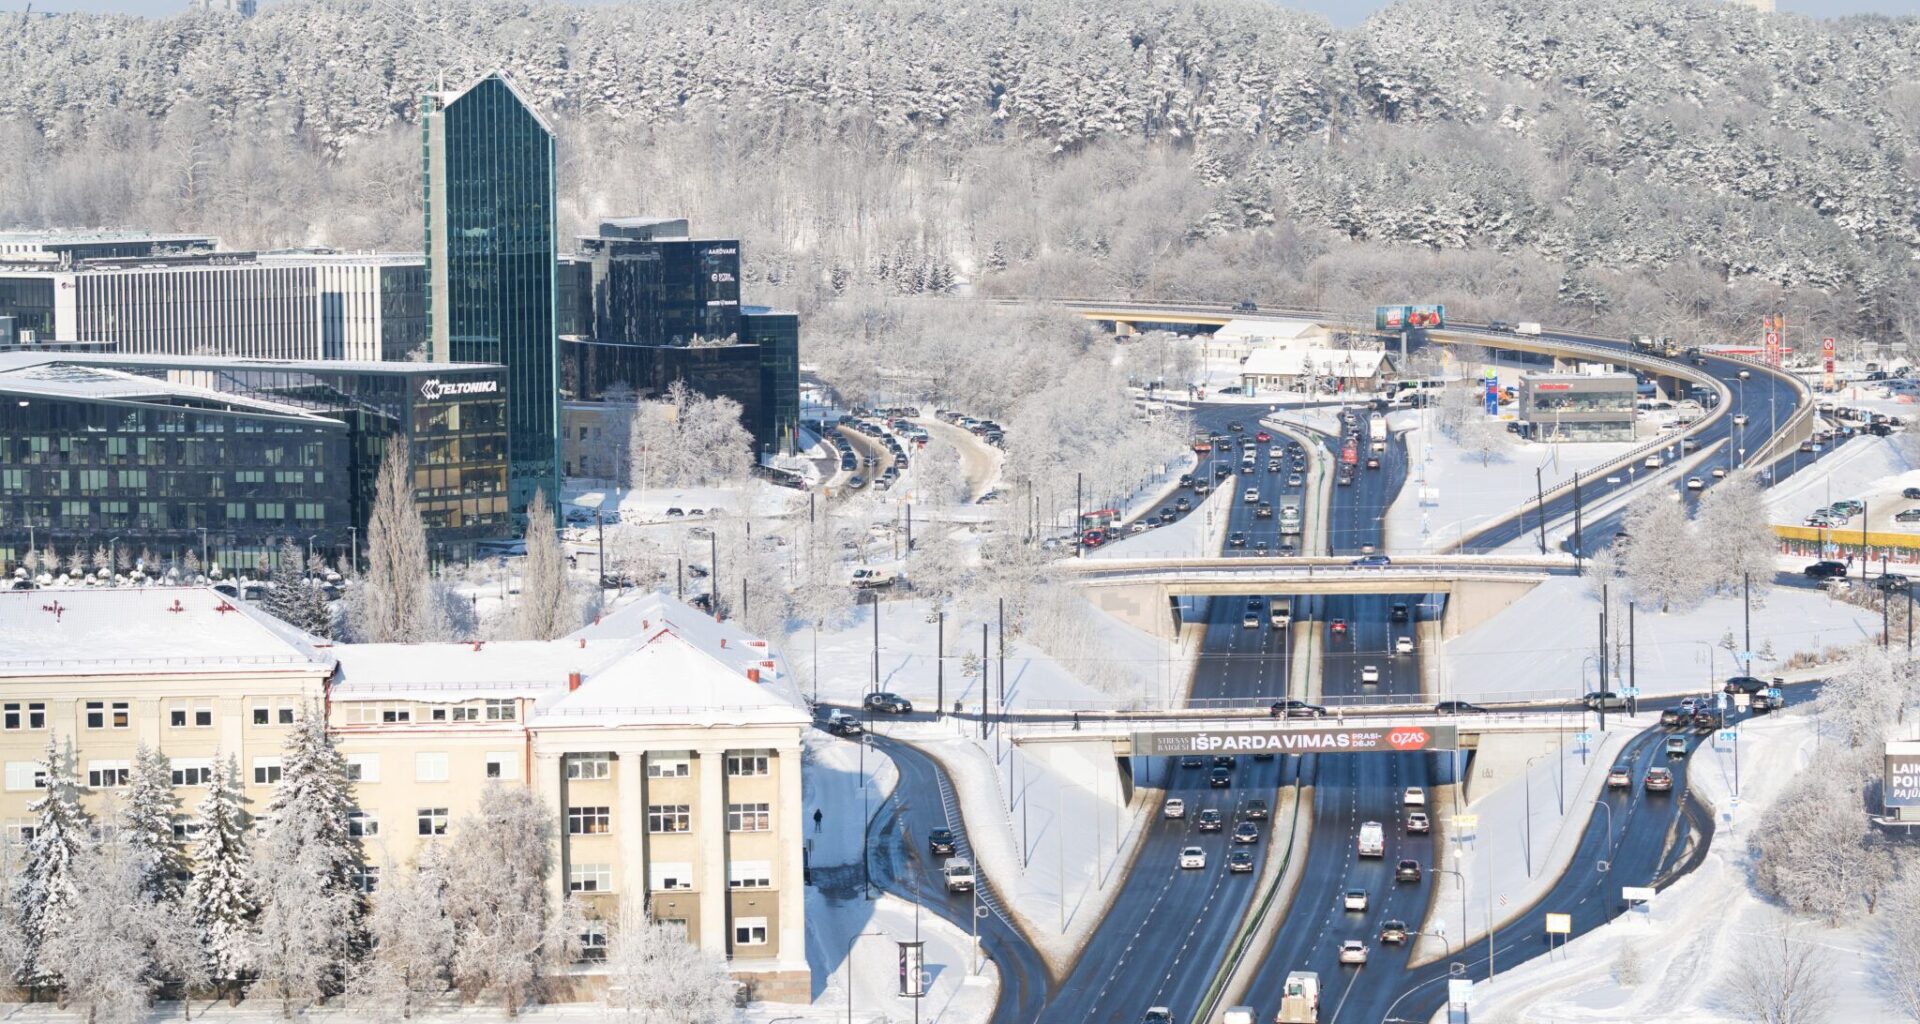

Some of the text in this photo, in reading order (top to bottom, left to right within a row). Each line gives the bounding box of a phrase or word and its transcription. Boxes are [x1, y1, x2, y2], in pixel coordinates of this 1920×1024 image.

[438, 381, 497, 394] TELTONIKA
[1191, 733, 1350, 751] IŠPARDAVIMAS
[1391, 732, 1424, 745] OZAS
[1892, 776, 1920, 787] POI
[1893, 788, 1920, 800] PAJŪ
